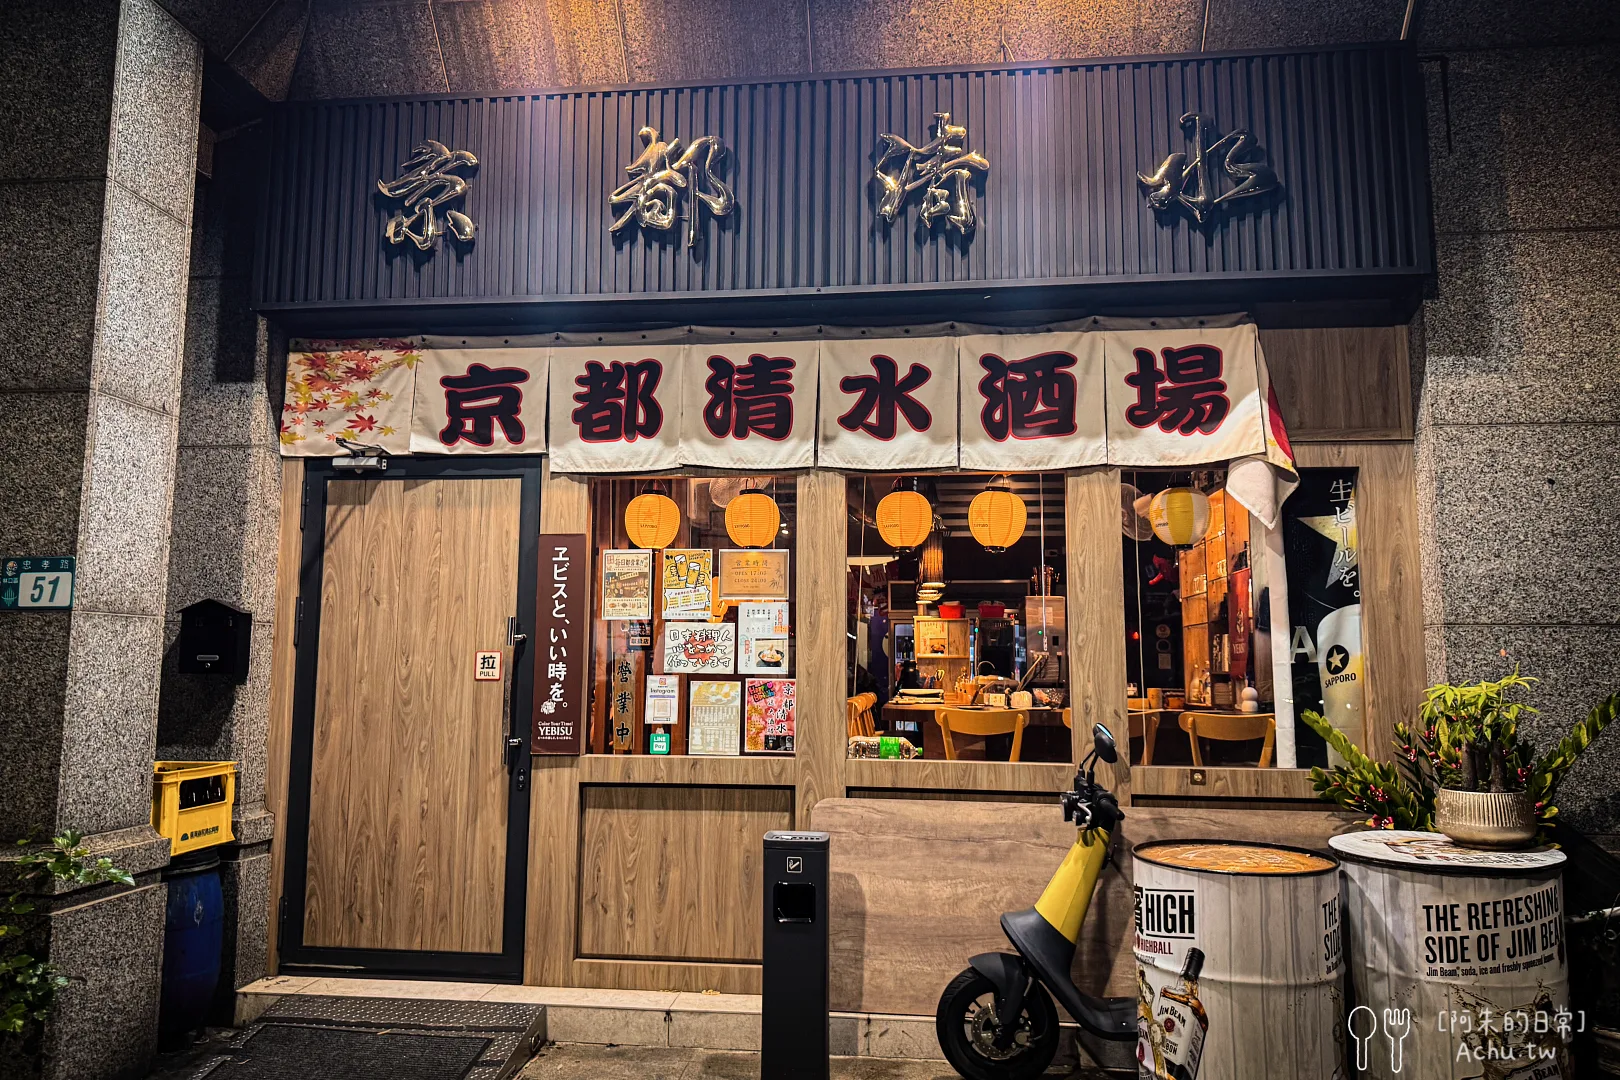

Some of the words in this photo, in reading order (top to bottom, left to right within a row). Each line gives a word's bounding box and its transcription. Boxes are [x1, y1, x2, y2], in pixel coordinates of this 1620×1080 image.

[438, 342, 1231, 447] 京都清水酒場
[1329, 478, 1360, 597] 生ビールを。
[22, 559, 69, 570] 忠孝路
[30, 575, 60, 603] 51
[670, 629, 732, 642] 日本料理人
[672, 643, 727, 654] 心をこめて
[480, 655, 496, 670] 拉
[667, 655, 731, 668] 作っています
[1324, 672, 1357, 689] SAPPORO
[538, 726, 573, 736] YEBISU
[1145, 893, 1195, 934] HIGH
[1322, 896, 1337, 930] THE
[1422, 904, 1461, 932] THE
[1467, 885, 1559, 931] REFRESHING
[1140, 938, 1173, 955] HIGHBALL
[1424, 935, 1471, 964] SIDE
[1477, 933, 1500, 962] OF
[1506, 926, 1537, 959] JIM
[1426, 966, 1439, 977] Jim
[1461, 966, 1478, 977] soda,
[1479, 966, 1488, 975] ice
[1489, 964, 1501, 974] and
[1502, 961, 1522, 974] freshly
[1522, 955, 1543, 972] squeezed
[1157, 1005, 1170, 1017] JIM
[1169, 1005, 1187, 1028] BEAM
